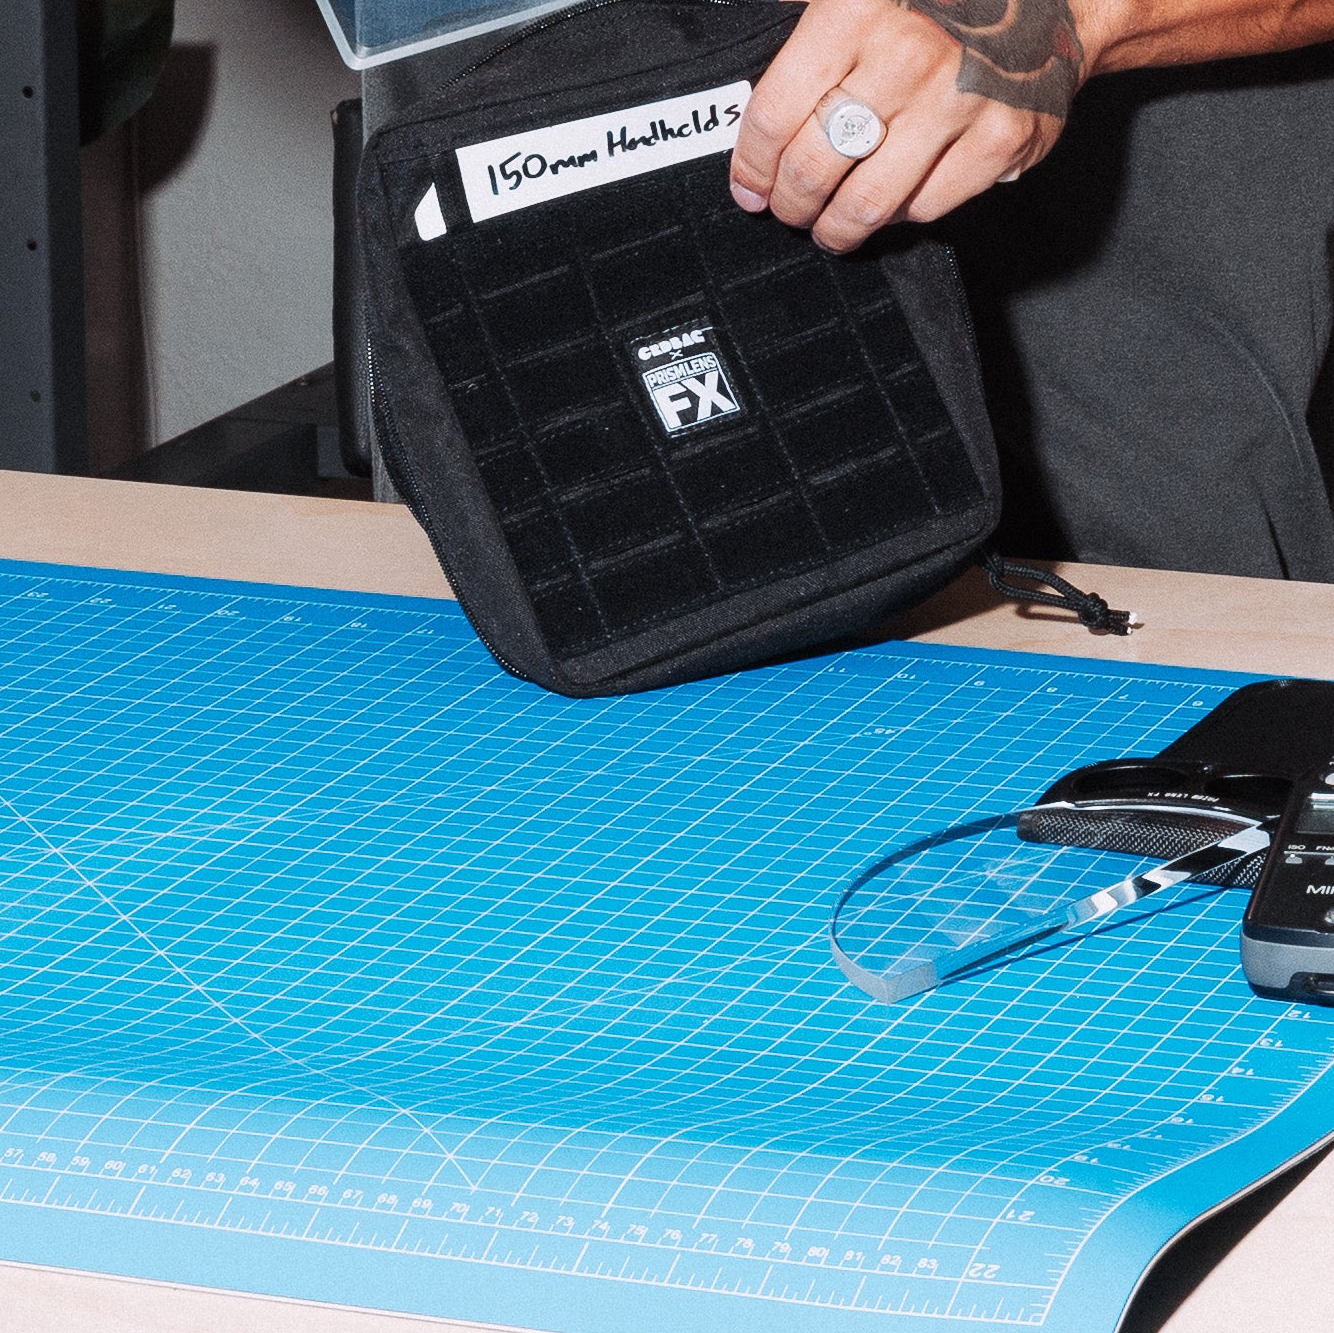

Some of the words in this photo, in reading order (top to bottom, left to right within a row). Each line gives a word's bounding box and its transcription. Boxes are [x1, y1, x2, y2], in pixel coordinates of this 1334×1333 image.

[488, 151, 598, 195] 150mm
[646, 362, 688, 388] PRISM
[686, 356, 717, 377] LENS
[653, 371, 736, 429] FX
